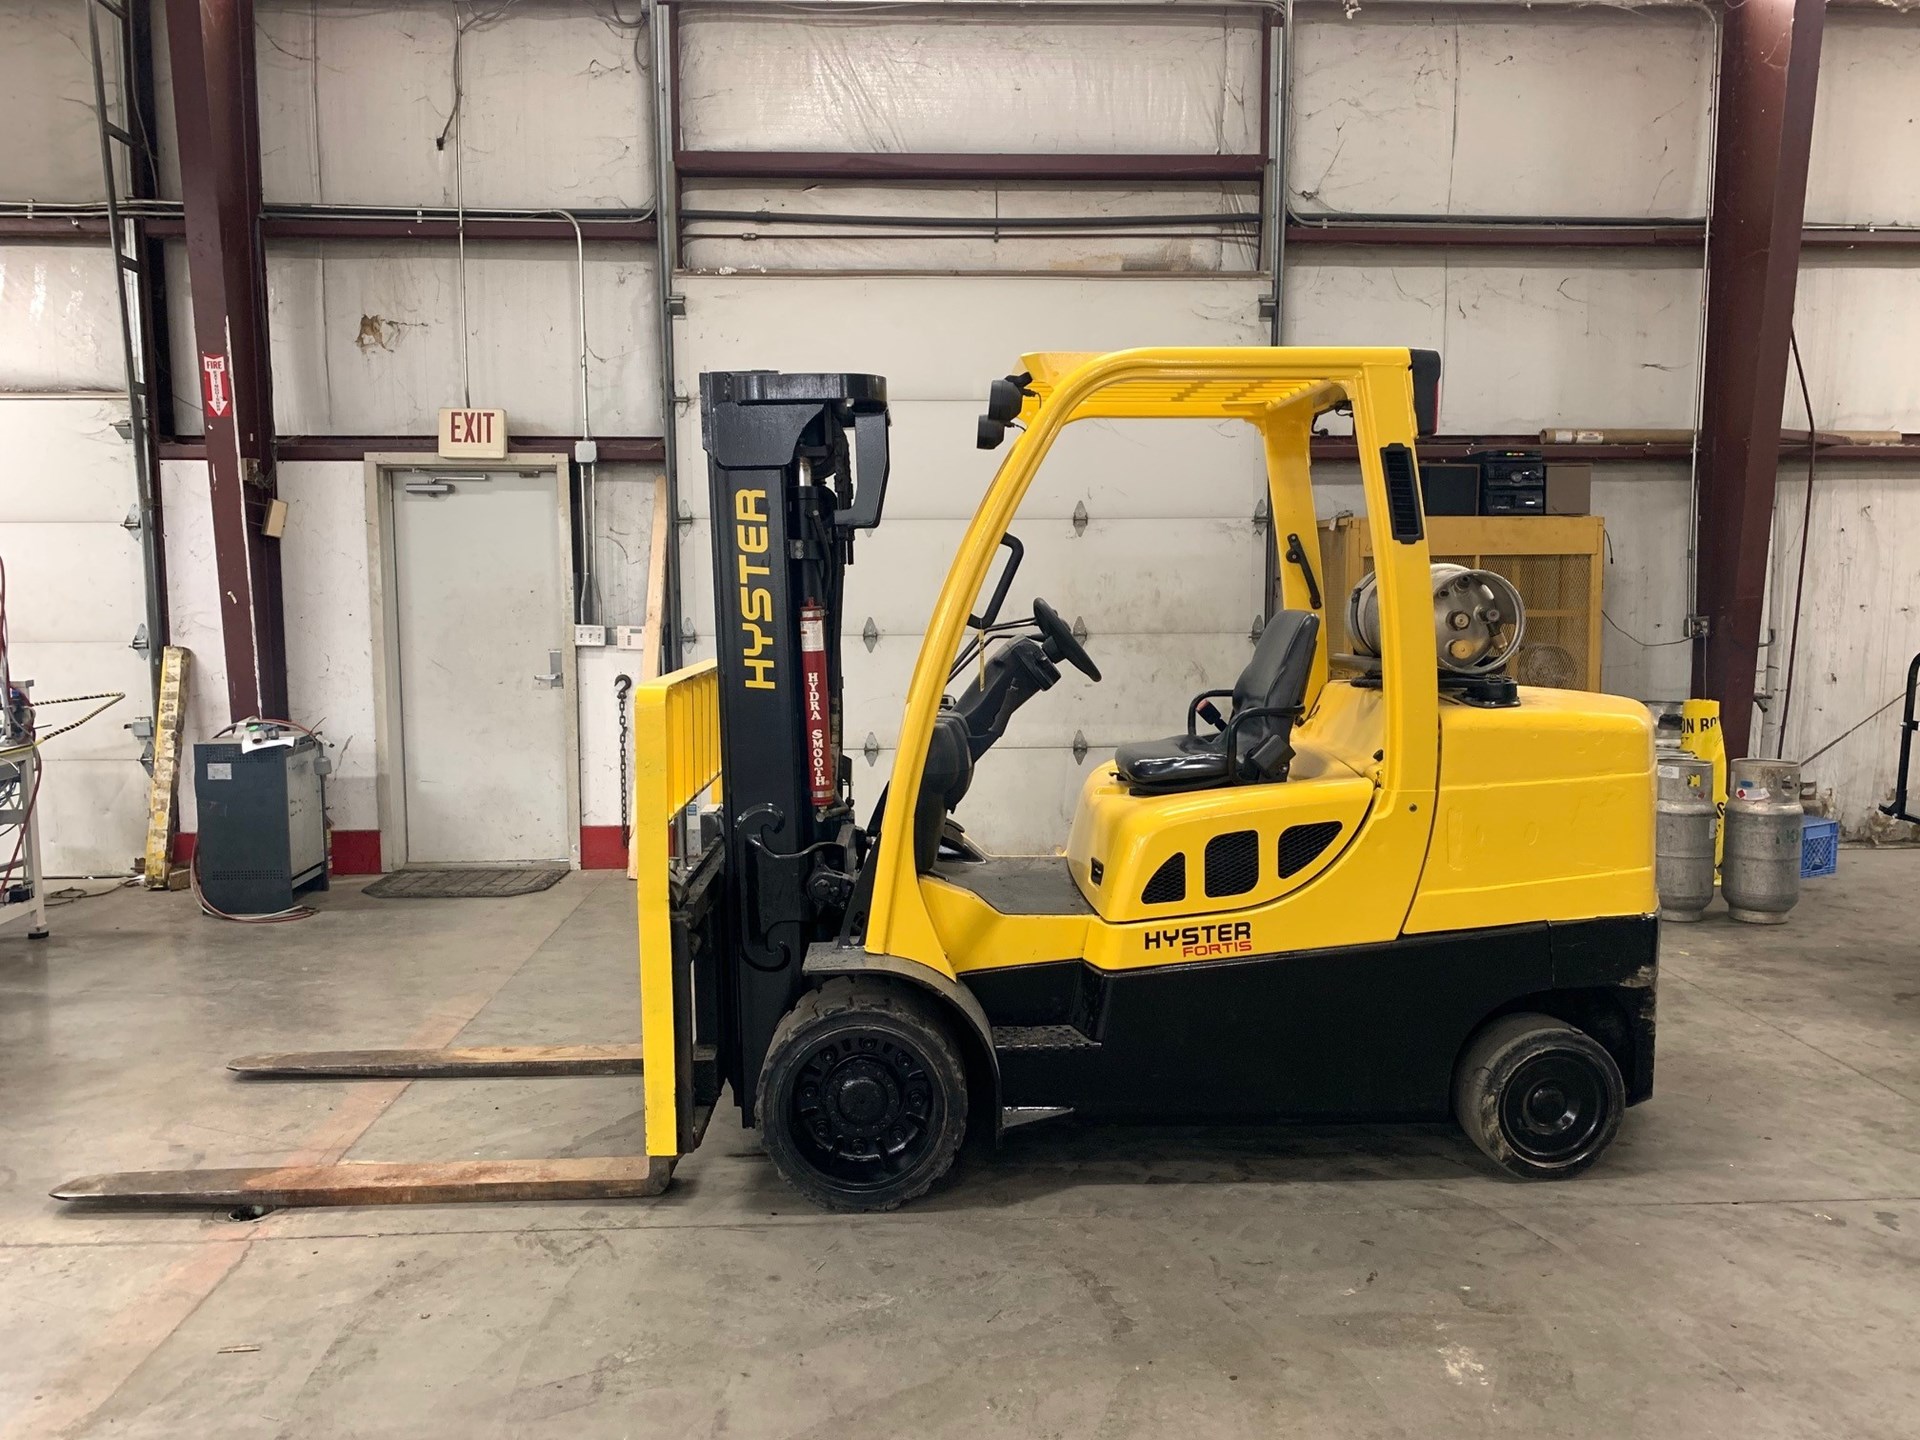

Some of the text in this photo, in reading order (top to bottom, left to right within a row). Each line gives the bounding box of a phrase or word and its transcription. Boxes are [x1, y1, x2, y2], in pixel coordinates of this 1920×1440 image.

[206, 360, 223, 370] FIRE
[451, 411, 495, 443] EXIT
[735, 488, 776, 690] HYSTER
[808, 672, 826, 786] HYDRA SMOOTH
[1144, 921, 1251, 950] HYSTER
[1182, 940, 1253, 958] FORTIS
